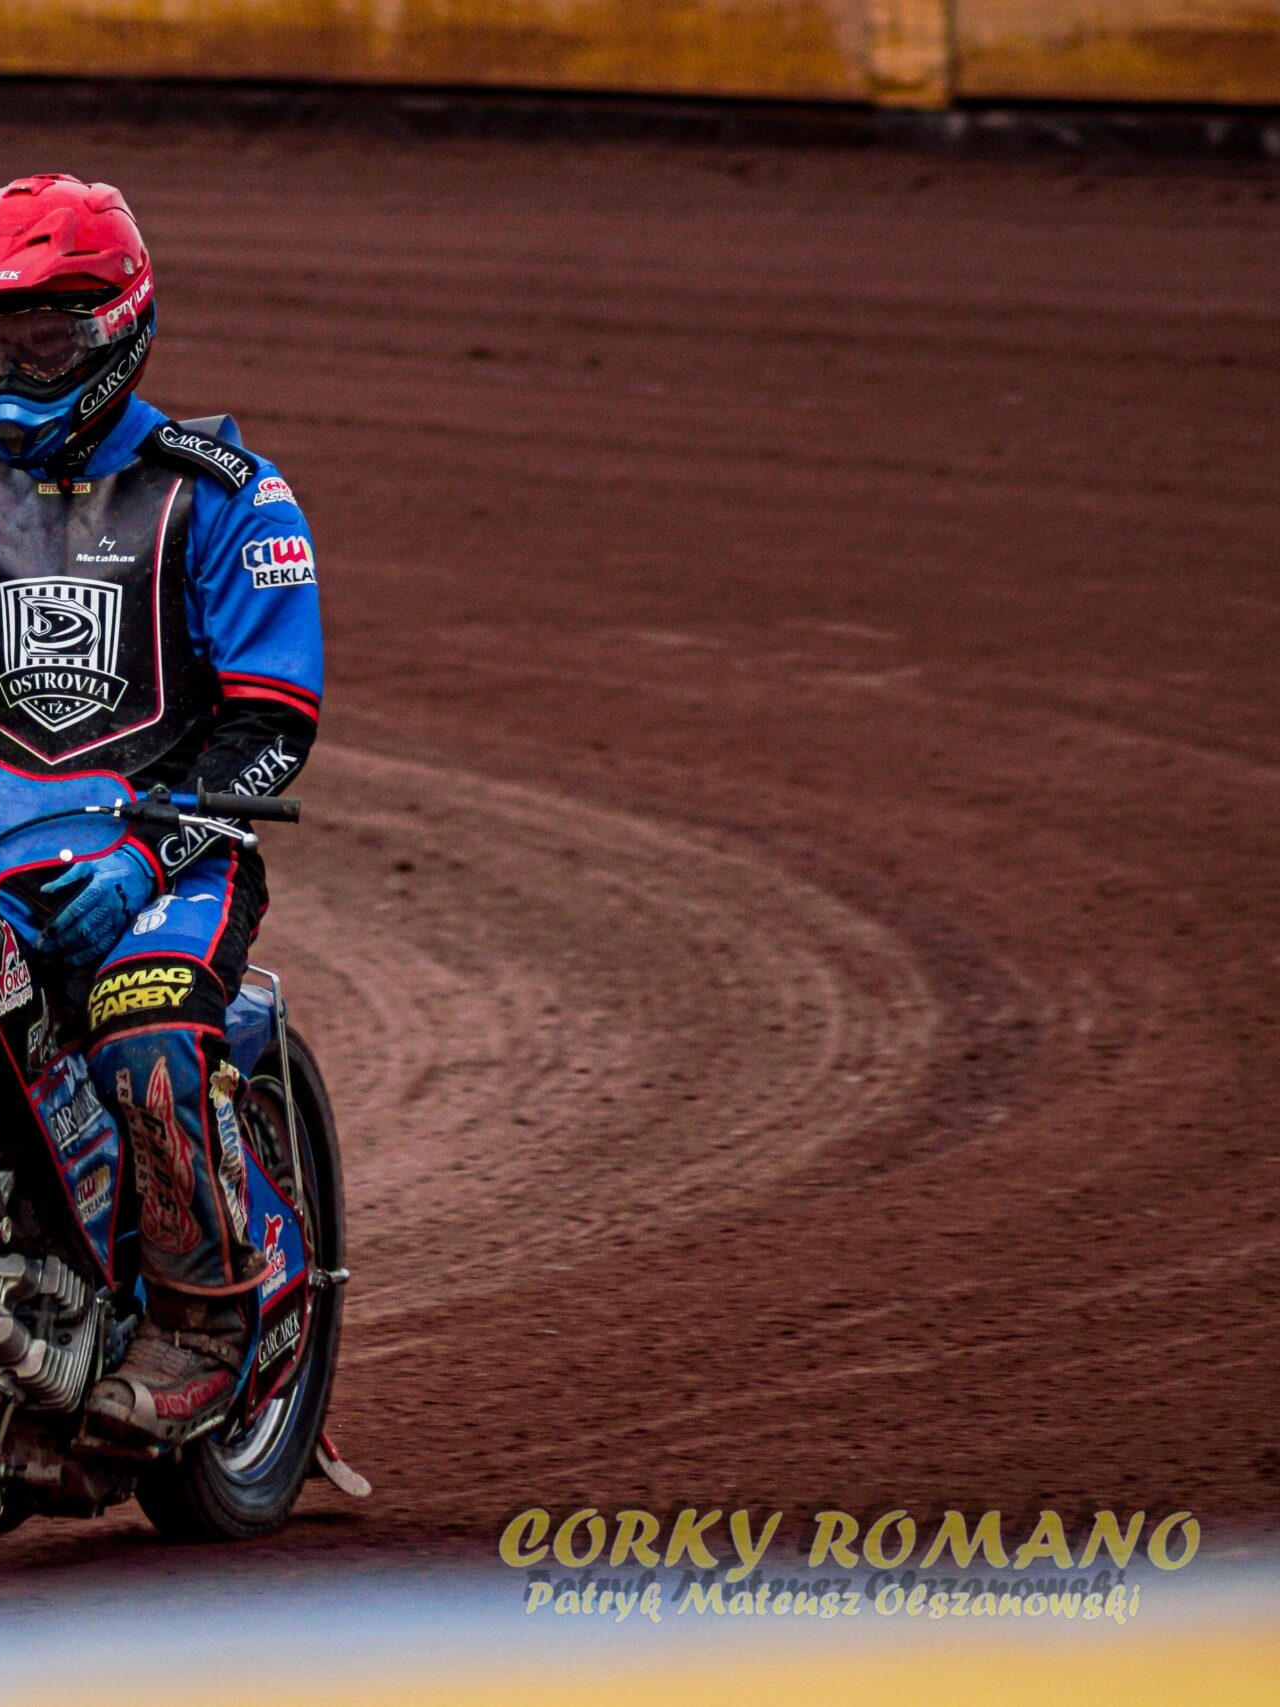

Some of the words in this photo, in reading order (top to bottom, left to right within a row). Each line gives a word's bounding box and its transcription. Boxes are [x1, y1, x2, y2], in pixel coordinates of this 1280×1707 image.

[162, 426, 253, 485] GARCAREK
[76, 553, 136, 563] Metalkas
[9, 672, 110, 700] OSTROVIA
[5, 963, 29, 992] ORCA
[90, 967, 193, 1004] KAMAG
[91, 985, 189, 1032] FARBY
[257, 1311, 300, 1364] GARCAREK
